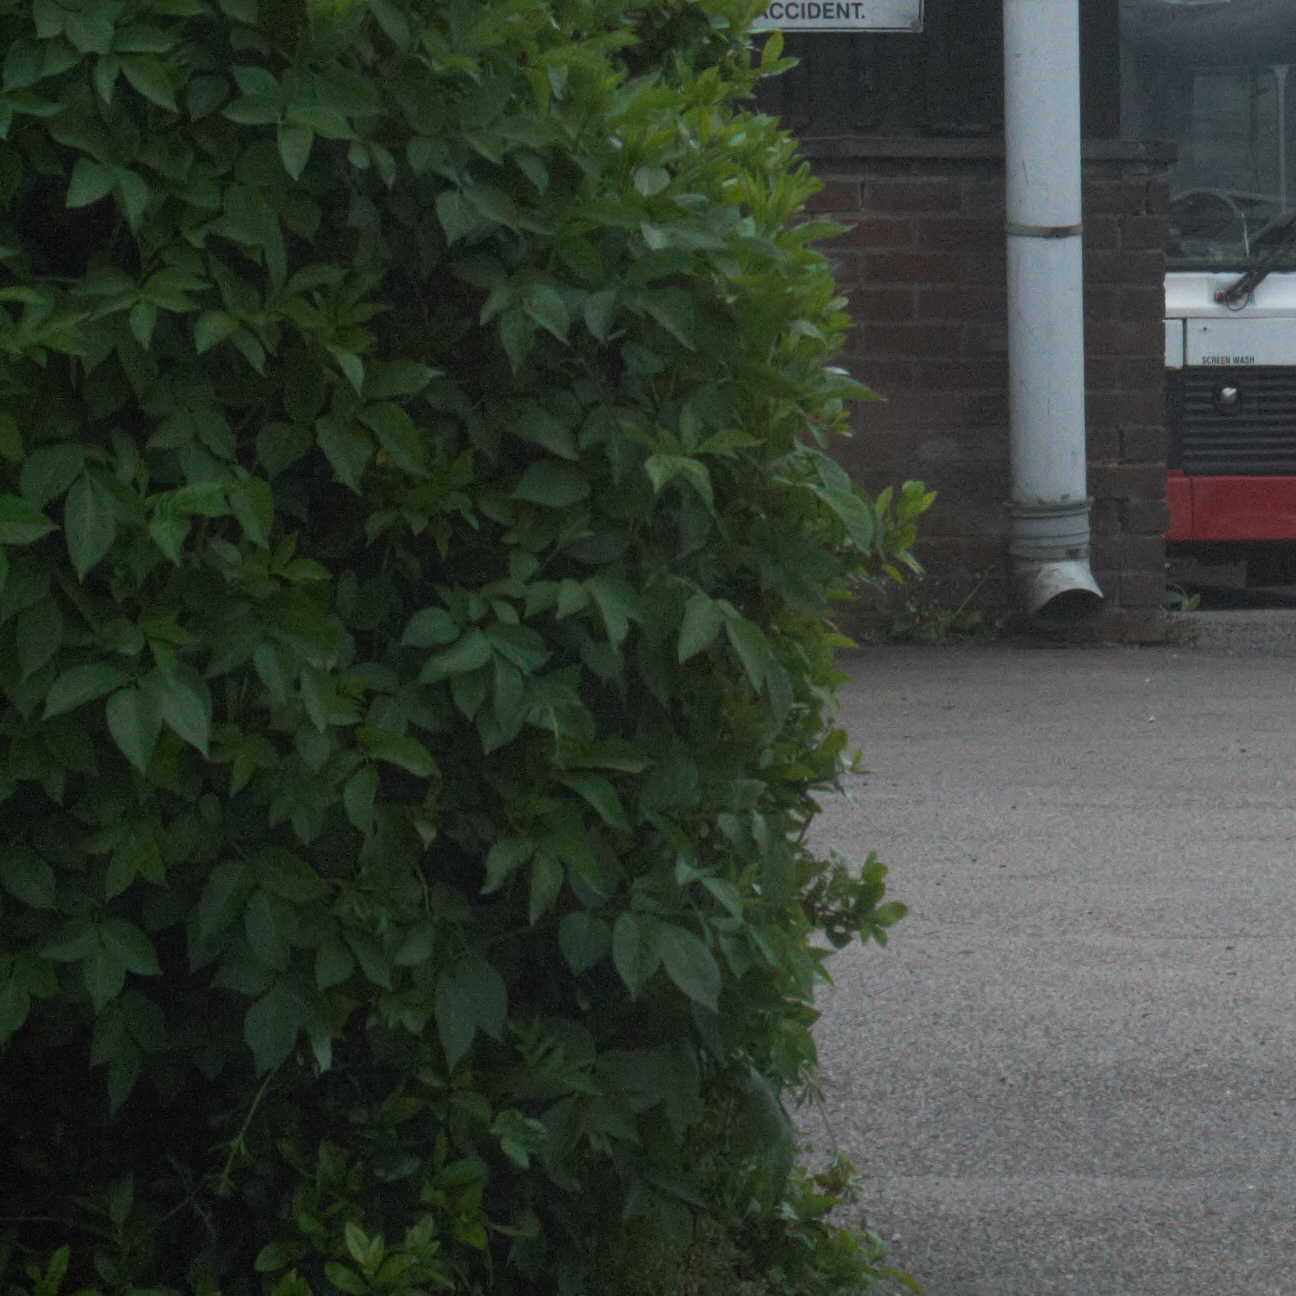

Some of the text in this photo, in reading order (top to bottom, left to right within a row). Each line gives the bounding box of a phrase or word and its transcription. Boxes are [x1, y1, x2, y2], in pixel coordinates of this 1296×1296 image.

[761, 3, 866, 19] CCIDENT.
[1201, 355, 1255, 364] SCREEN WASH
